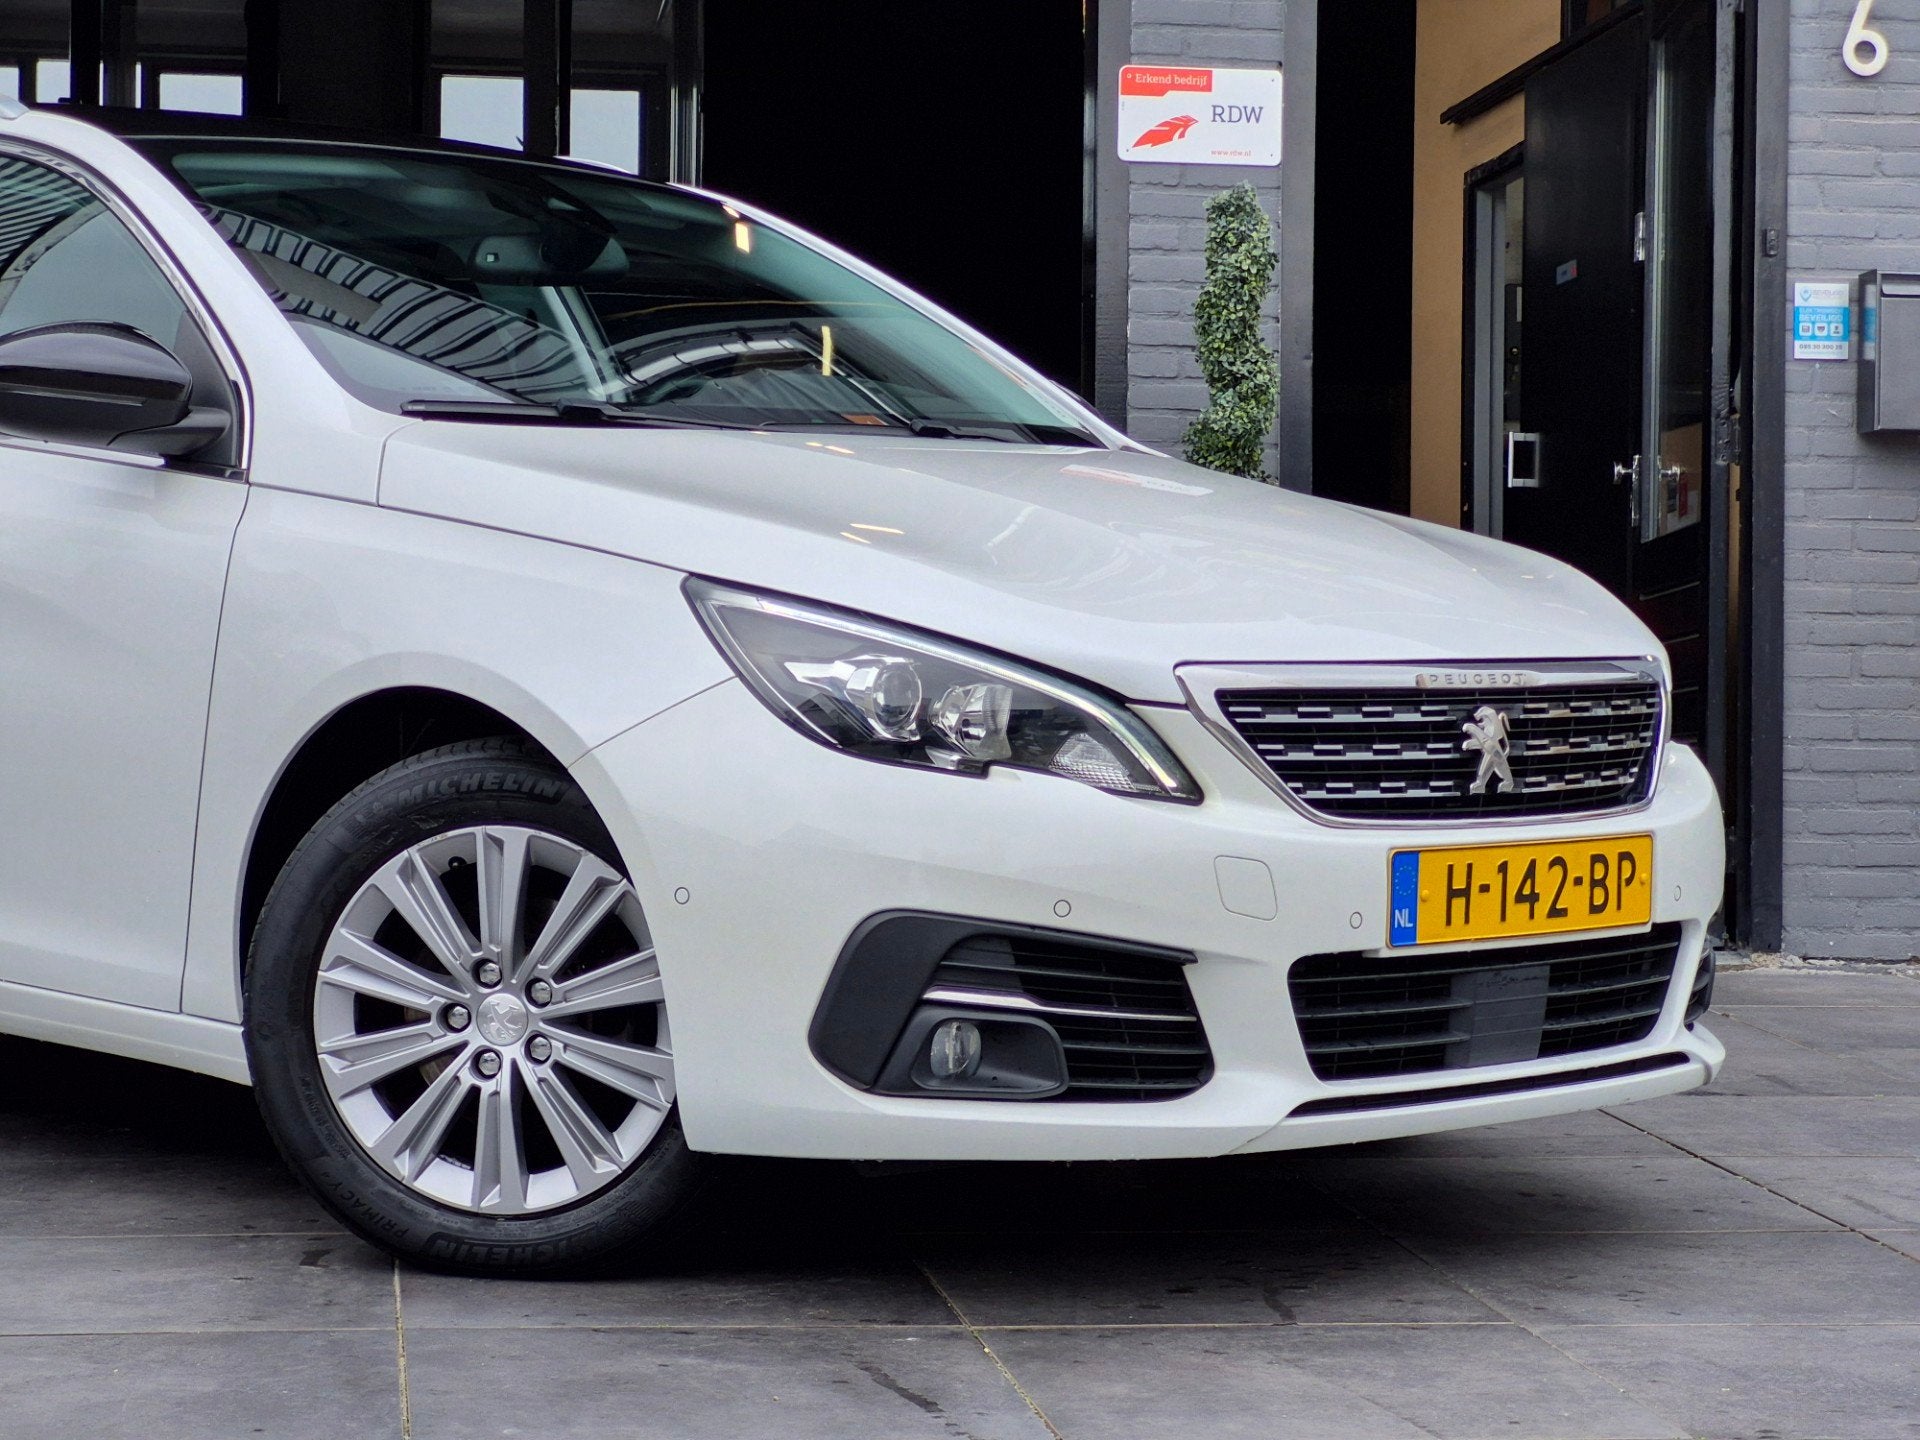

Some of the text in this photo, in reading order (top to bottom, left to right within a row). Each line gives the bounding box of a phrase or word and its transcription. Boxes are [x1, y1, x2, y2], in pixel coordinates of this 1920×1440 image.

[1842, 0, 1888, 76] 6
[1135, 73, 1208, 87] Erkend bedrijf
[1210, 104, 1264, 124] RDW
[1210, 149, 1252, 157] www.rdw.nl
[1429, 673, 1525, 685] PEUGEOT
[398, 771, 563, 807] MICHELIN
[1445, 850, 1637, 927] H-142-BP
[1394, 908, 1414, 929] NL
[326, 1180, 410, 1239] PRIMACY
